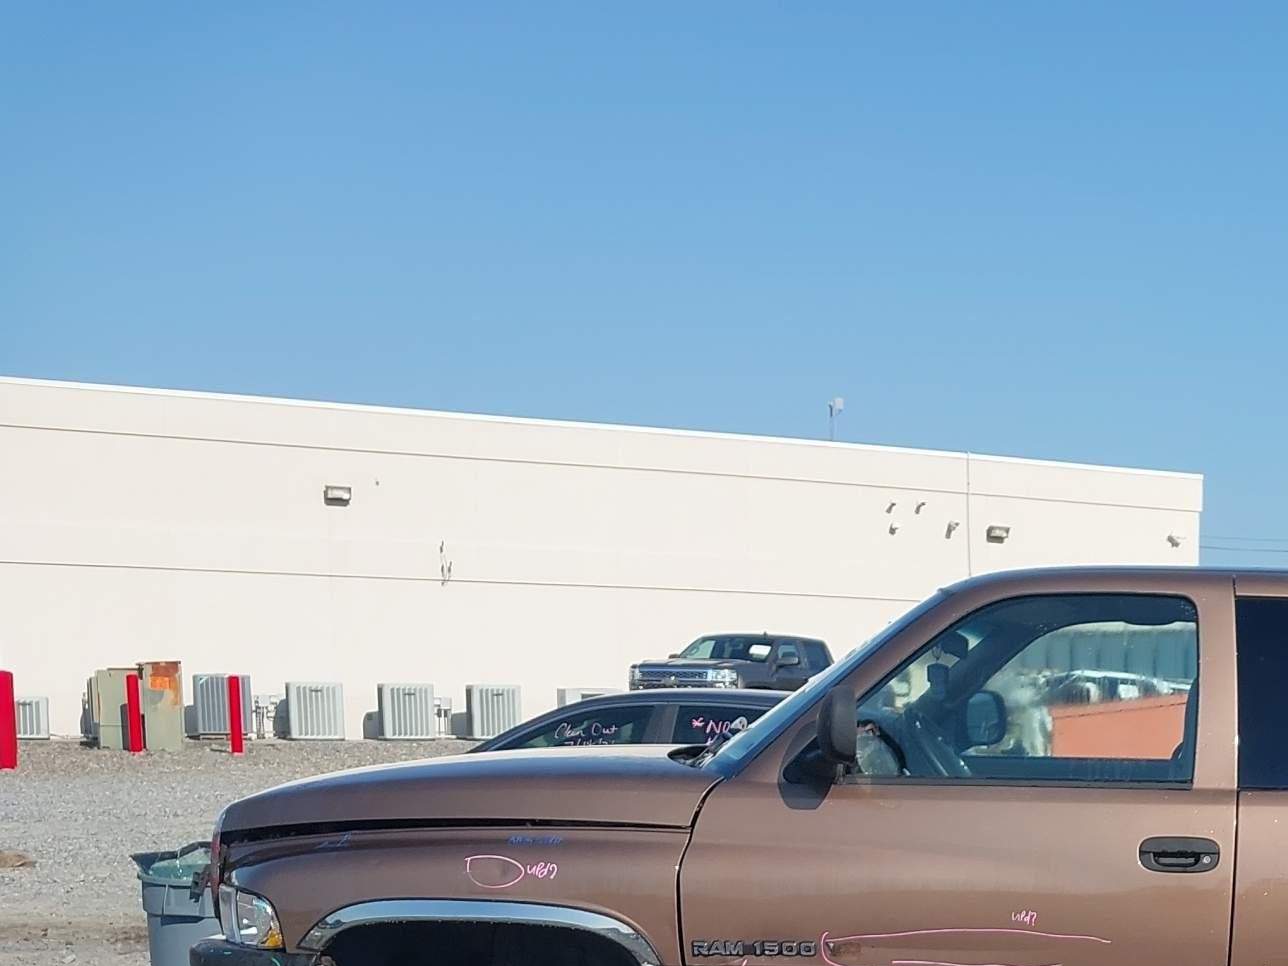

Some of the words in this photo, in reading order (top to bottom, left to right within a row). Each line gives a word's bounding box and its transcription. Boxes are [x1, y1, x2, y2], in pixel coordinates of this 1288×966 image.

[592, 722, 619, 736] Out
[692, 940, 744, 956] RAM
[752, 940, 817, 957] 1500
